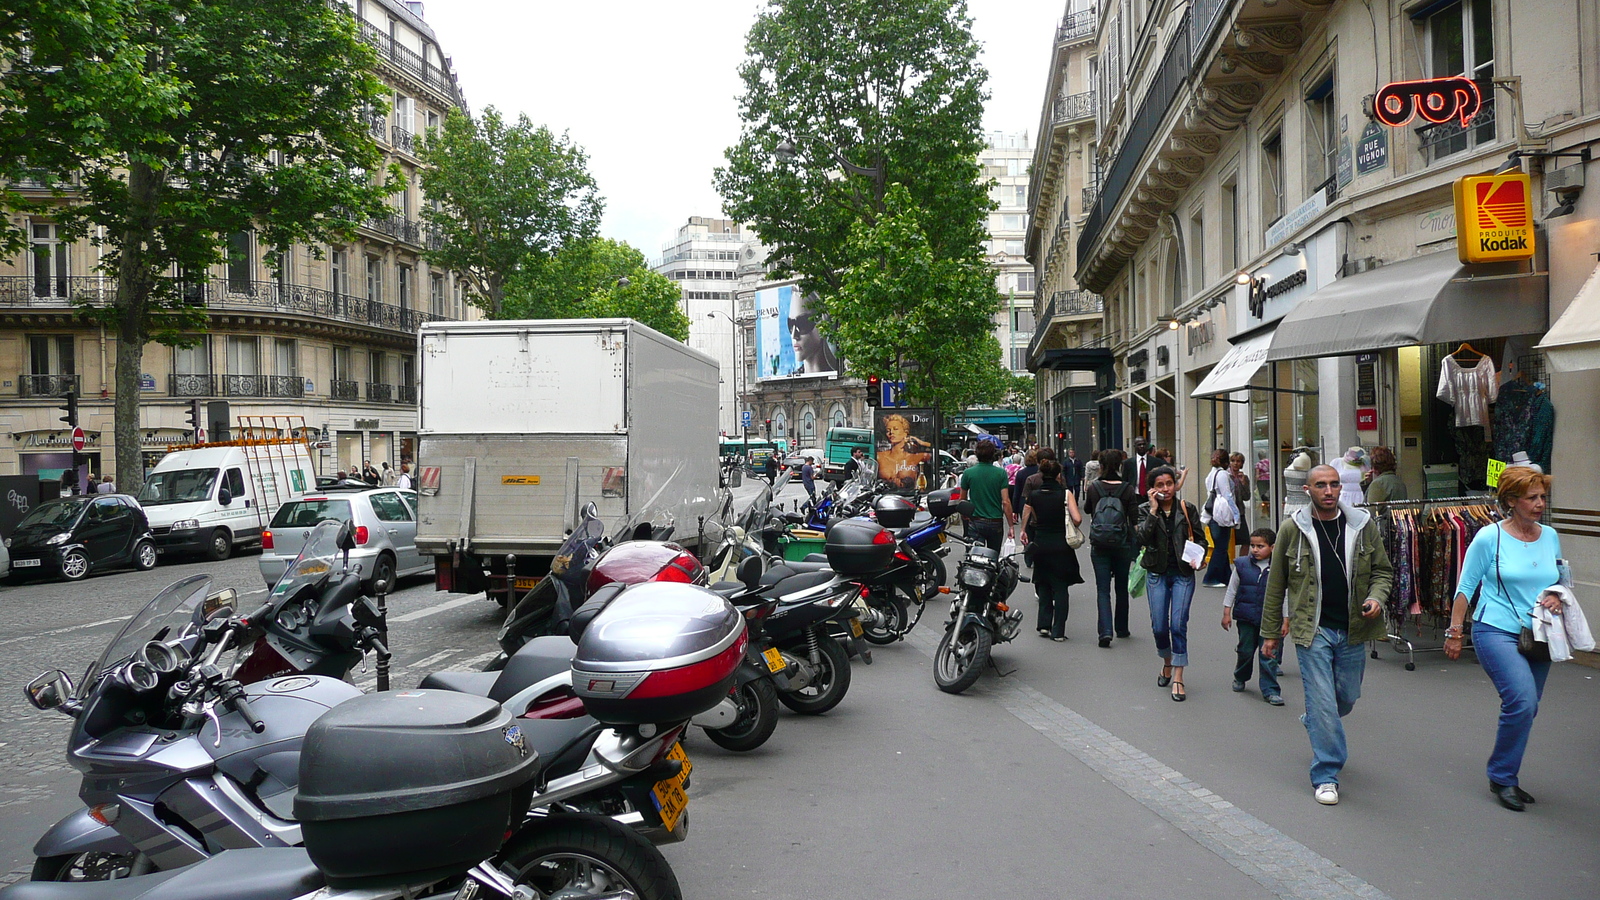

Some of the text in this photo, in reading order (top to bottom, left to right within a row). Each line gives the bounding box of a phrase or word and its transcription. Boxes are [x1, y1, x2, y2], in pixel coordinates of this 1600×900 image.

[1364, 140, 1378, 152] RUE
[1358, 147, 1384, 164] VIGNON
[1480, 236, 1528, 252] Kodak
[756, 307, 779, 317] PRADA
[912, 414, 929, 422] Dior
[672, 788, 682, 804] 78
[663, 797, 677, 820] EAK
